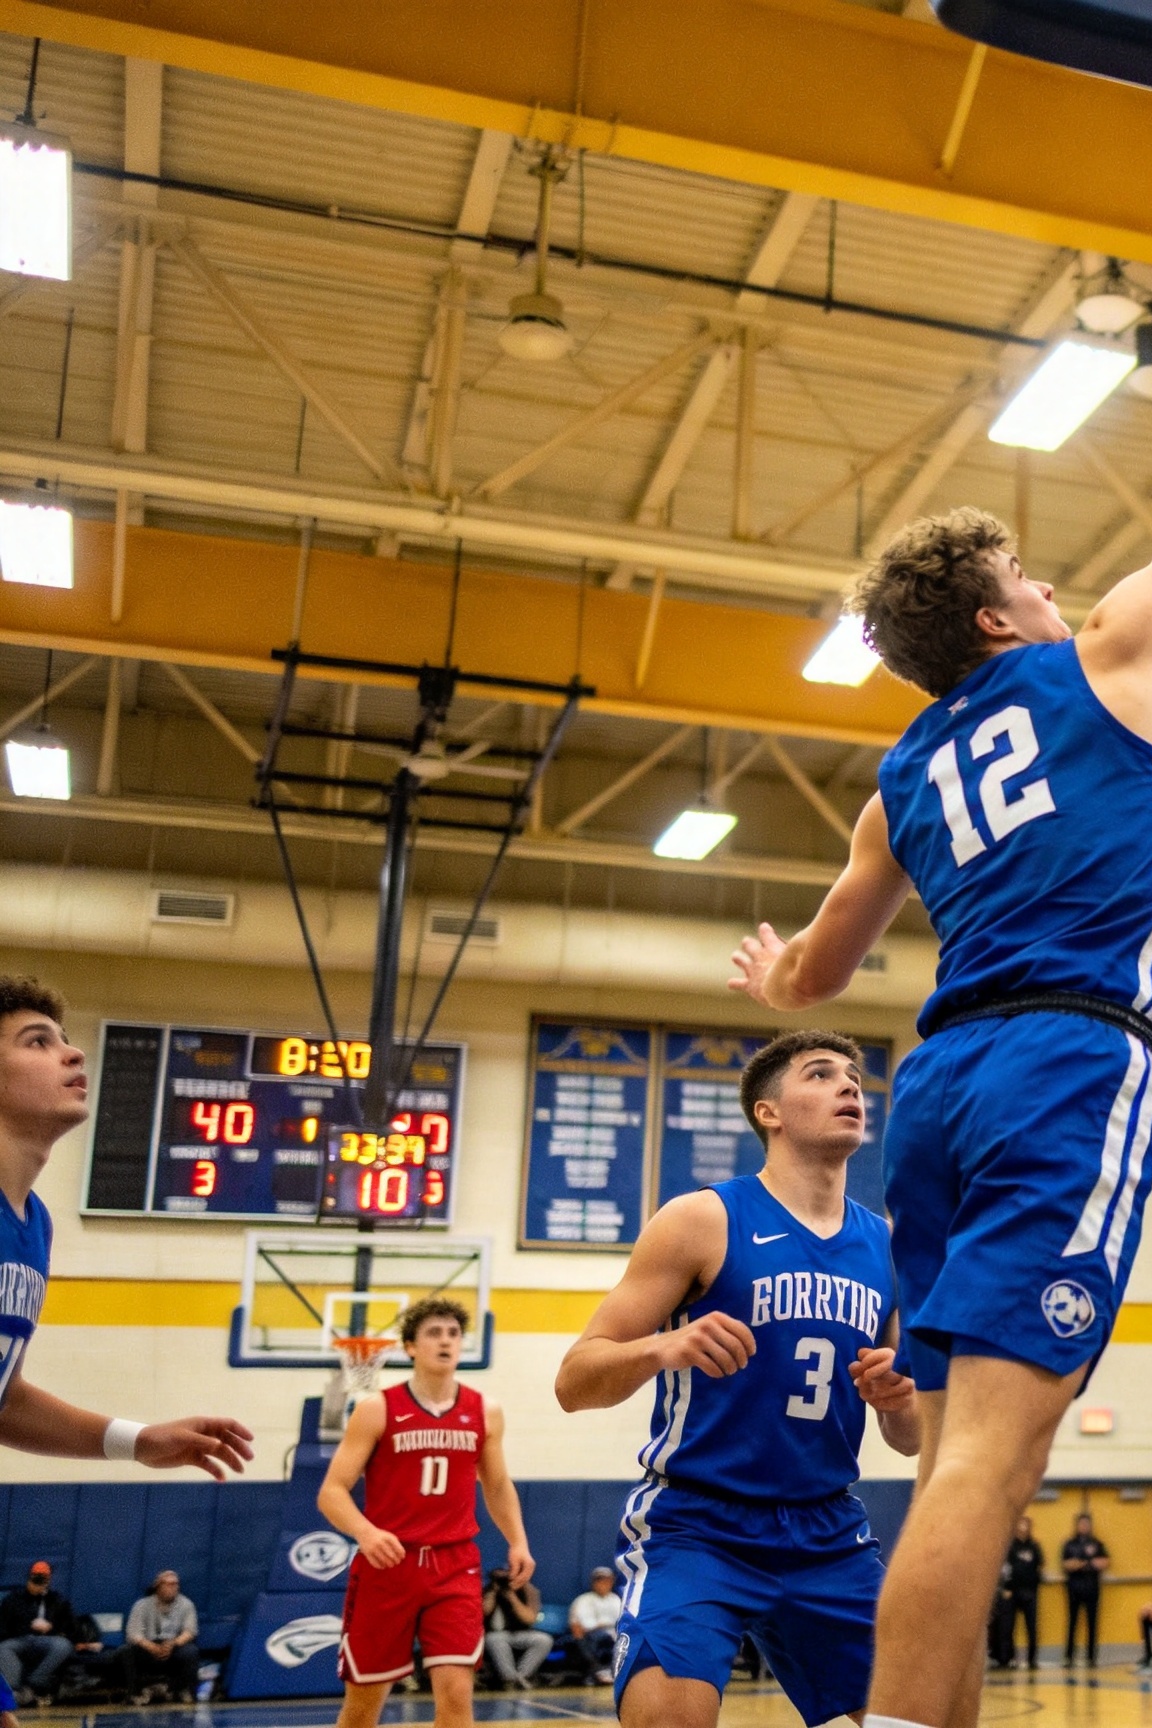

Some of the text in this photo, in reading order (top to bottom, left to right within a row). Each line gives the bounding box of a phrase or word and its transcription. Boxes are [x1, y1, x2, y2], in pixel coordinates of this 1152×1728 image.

[928, 705, 1056, 868] 12
[279, 1037, 372, 1079] 8:20
[192, 1101, 255, 1144] 40
[302, 1116, 319, 1144] 1
[192, 1159, 217, 1196] 3
[358, 1167, 409, 1212] 10
[786, 1337, 836, 1421] 3
